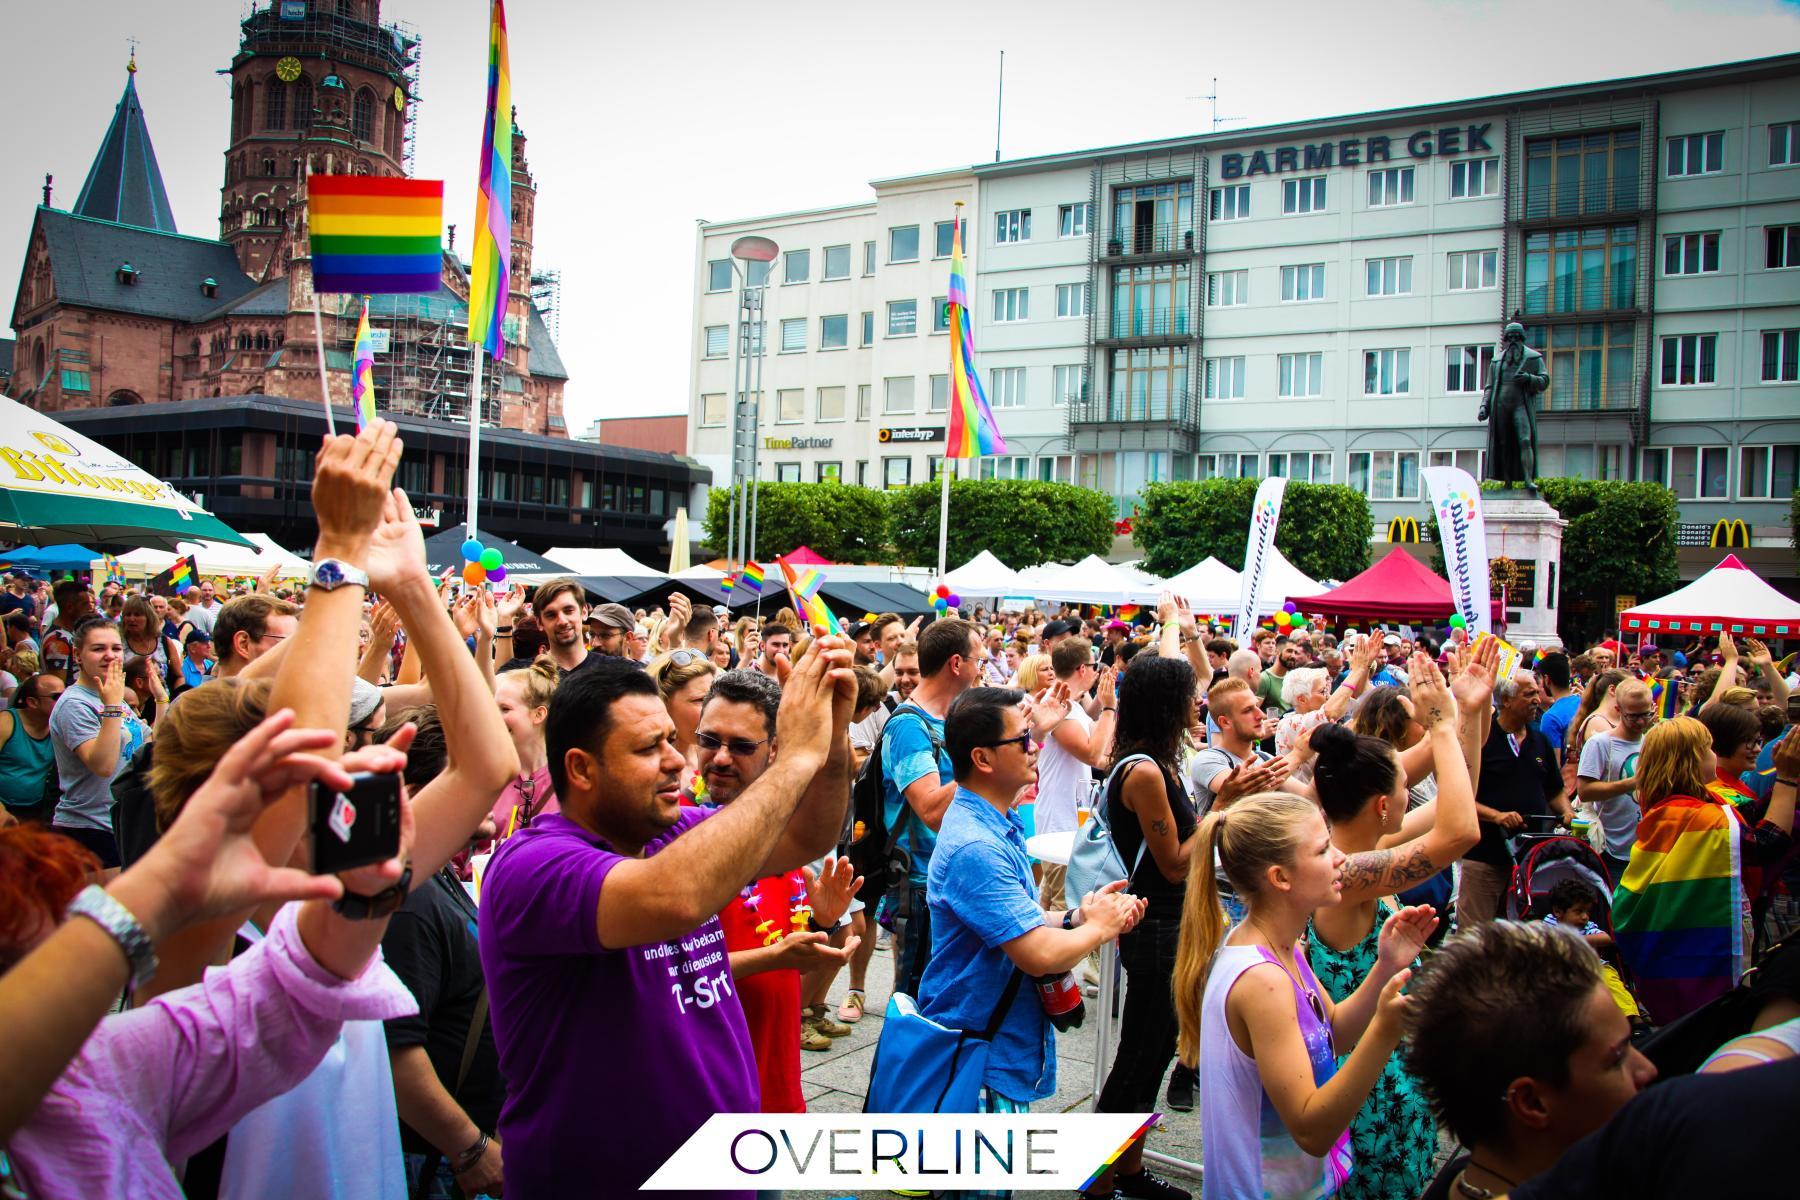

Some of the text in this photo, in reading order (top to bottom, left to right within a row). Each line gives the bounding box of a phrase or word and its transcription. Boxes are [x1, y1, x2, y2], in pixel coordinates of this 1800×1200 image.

[1221, 122, 1492, 179] BARMER GEK
[764, 436, 833, 449] TimePartner
[891, 428, 935, 440] interhyp
[1243, 510, 1270, 639] Schwuguntia
